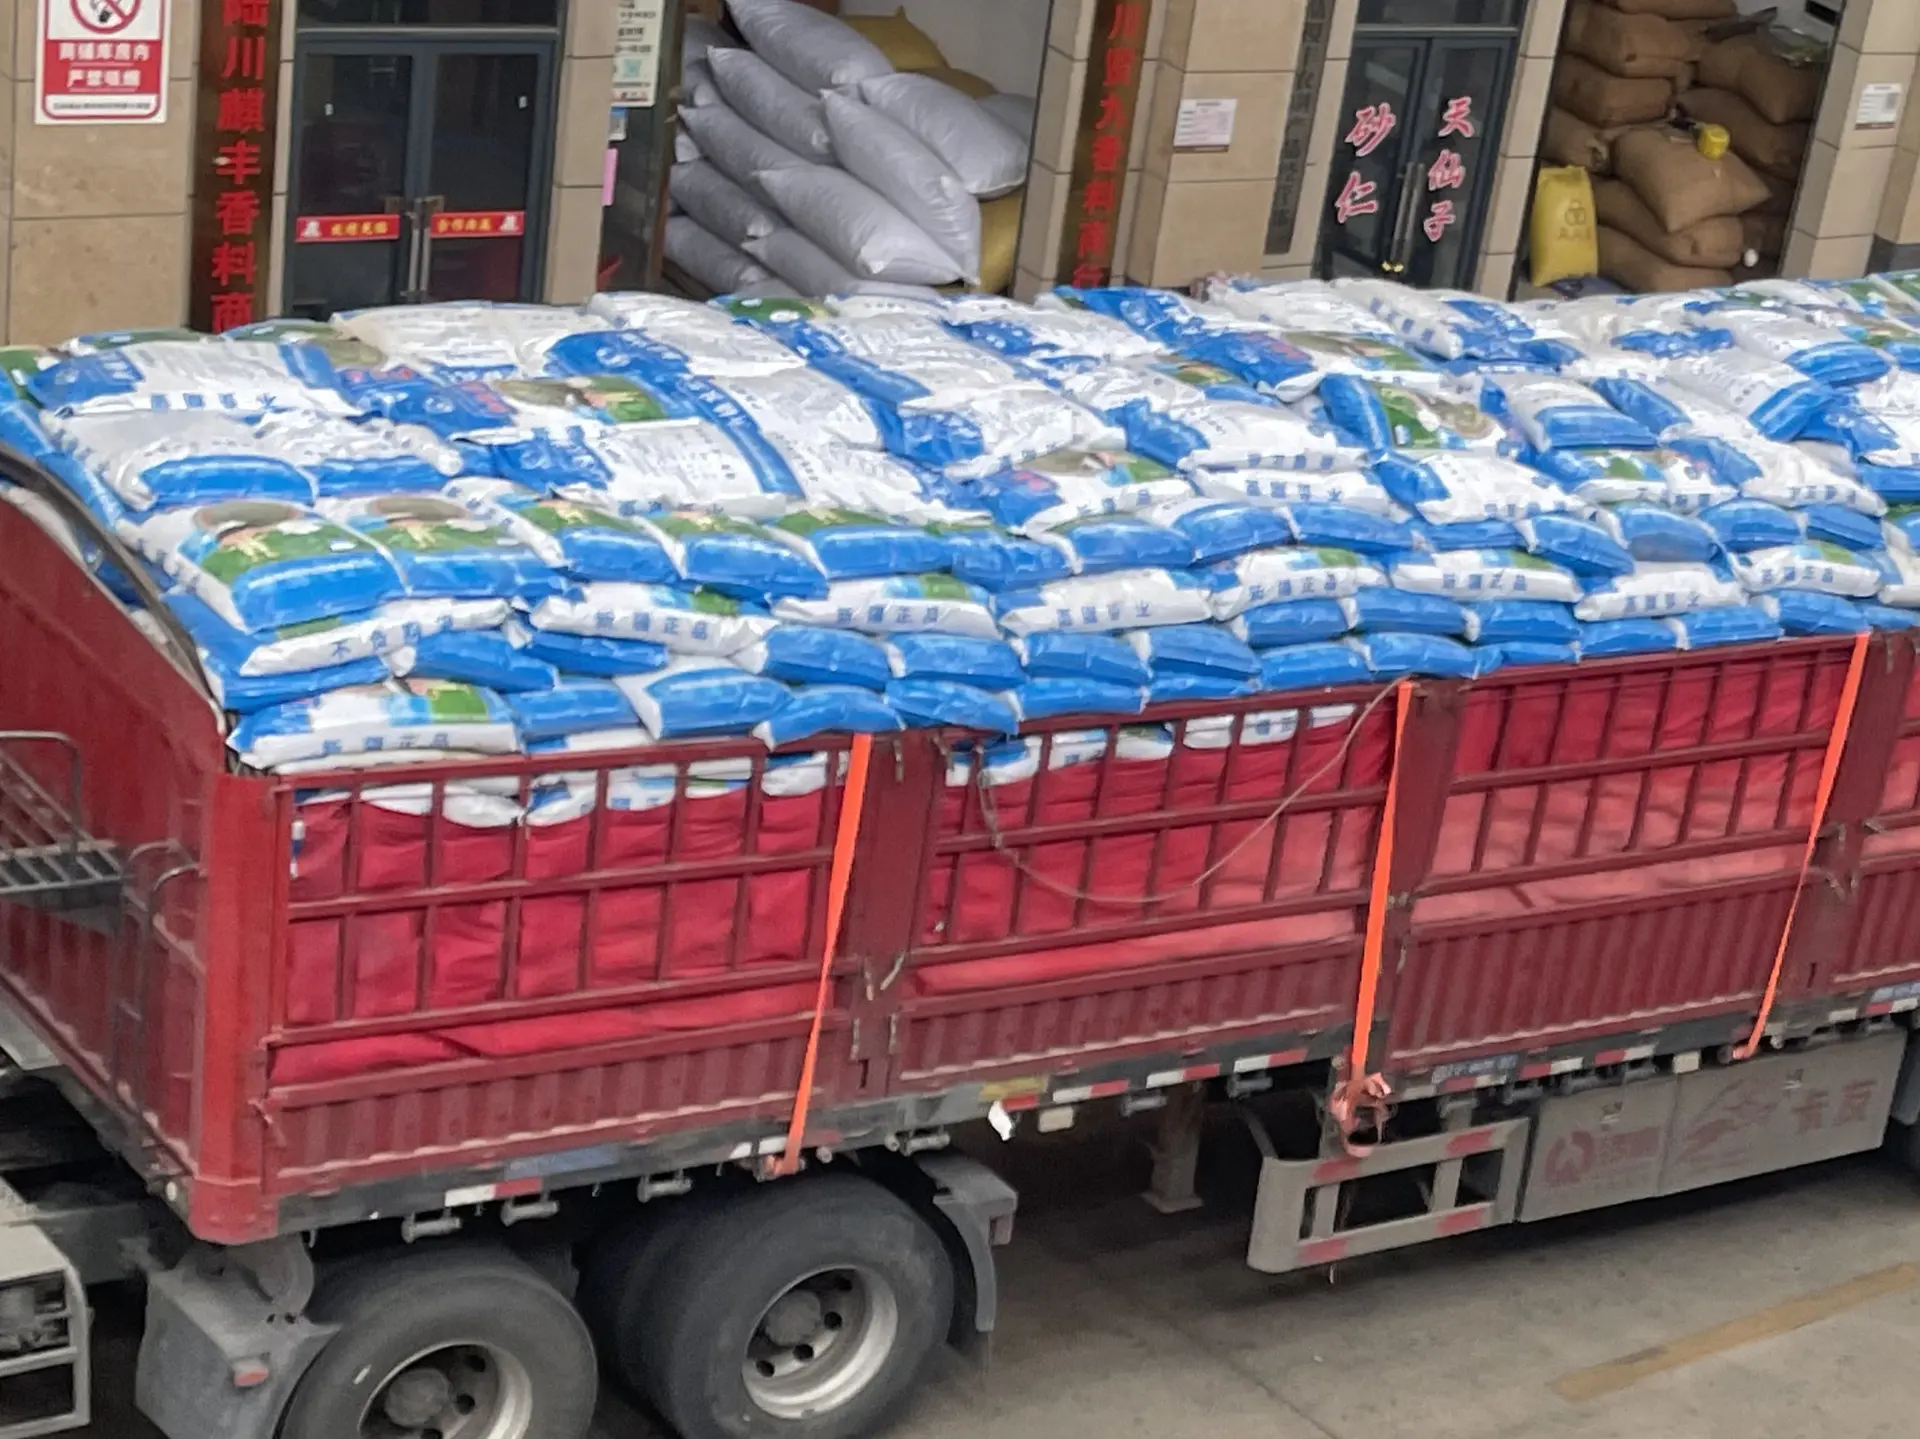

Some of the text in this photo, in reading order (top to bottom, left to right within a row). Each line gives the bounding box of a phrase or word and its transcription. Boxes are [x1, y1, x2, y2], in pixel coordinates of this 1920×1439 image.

[1335, 102, 1397, 224] 砂仁
[1423, 96, 1475, 242] 天仙子
